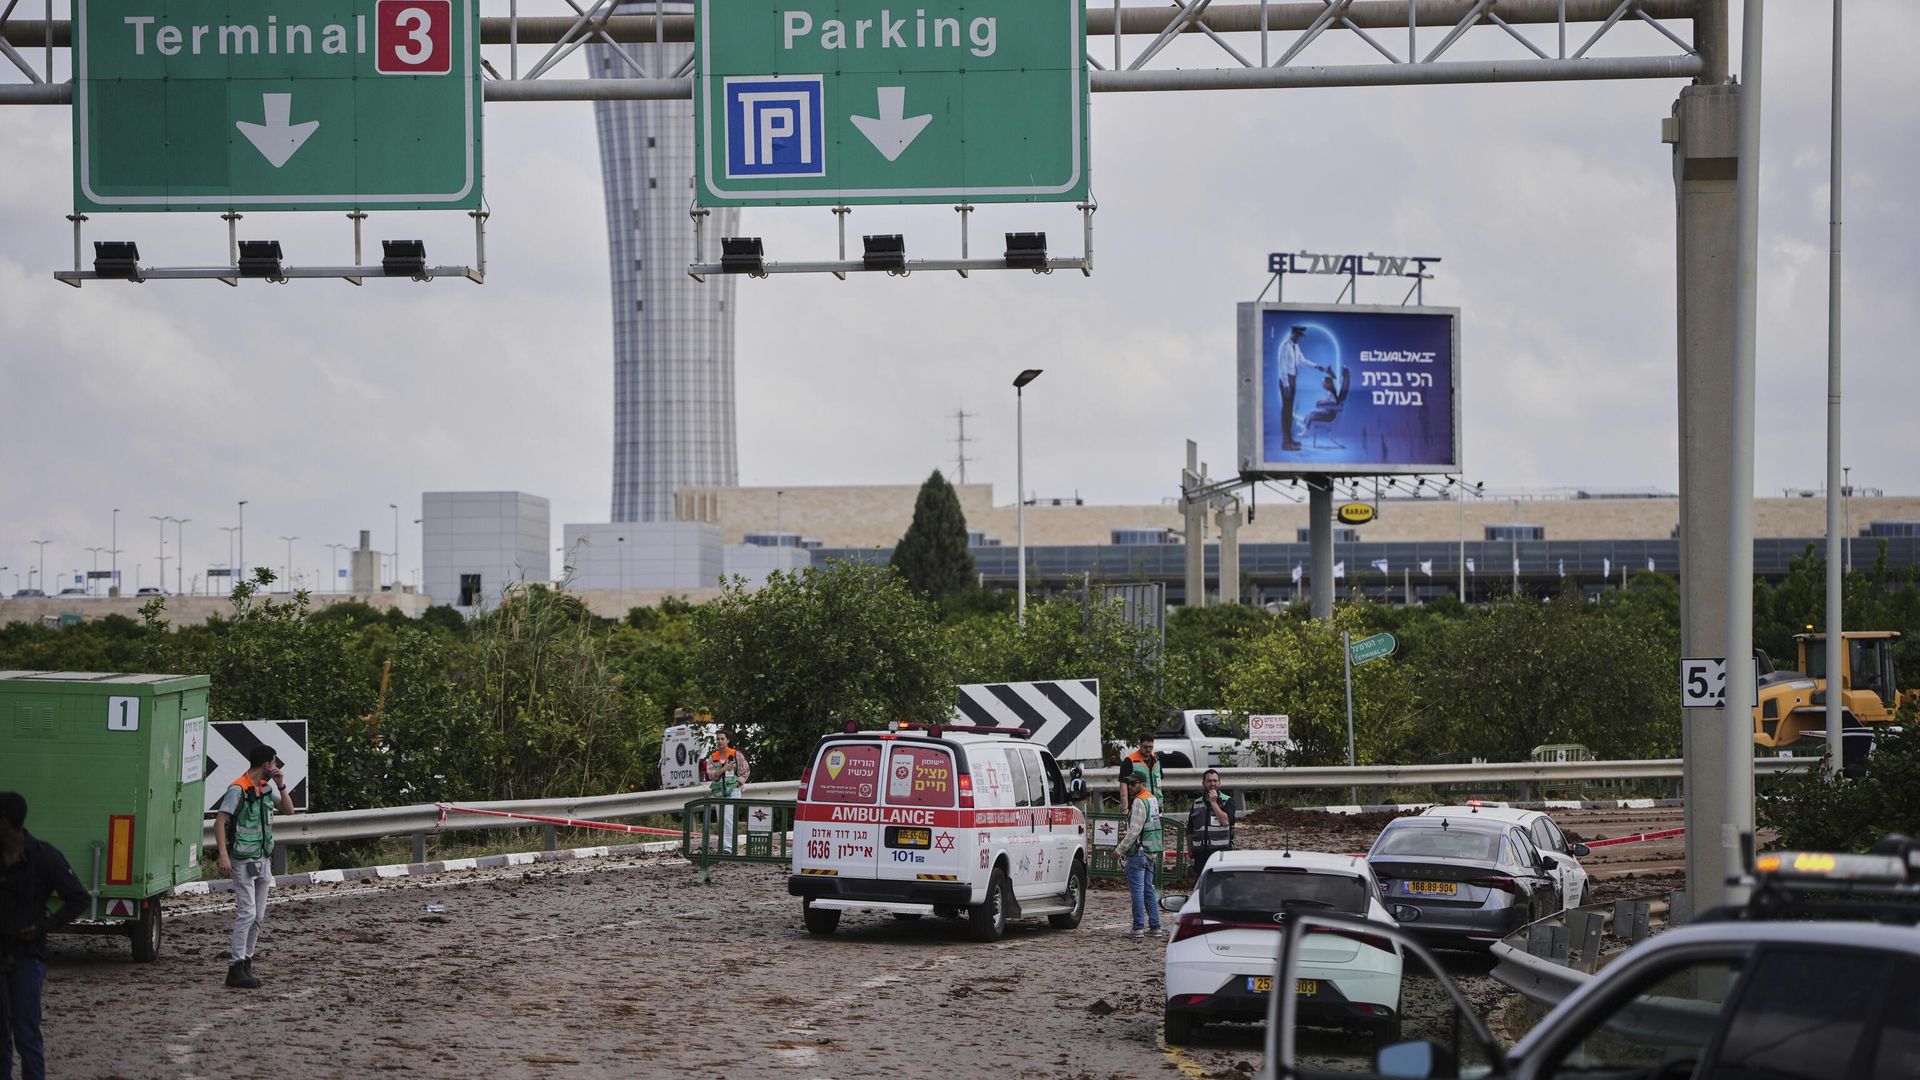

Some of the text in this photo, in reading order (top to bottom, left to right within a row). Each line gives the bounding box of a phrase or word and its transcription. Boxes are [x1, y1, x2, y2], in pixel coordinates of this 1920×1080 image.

[124, 8, 433, 65] Terminal 3
[783, 9, 998, 57] Parking
[1362, 371, 1433, 387] הכי בבית
[1372, 389, 1423, 406] בעולם
[120, 700, 128, 726] 1
[849, 759, 875, 768] הורידו
[670, 770, 693, 780] TOYOTA
[848, 768, 874, 777] עכשיו
[915, 765, 948, 779] מציל
[915, 780, 947, 792] חיים
[831, 806, 935, 825] AMBULANCE
[811, 828, 867, 840] מגן דוד אדום
[807, 840, 873, 859] איילון 1636
[892, 850, 914, 862] 101
